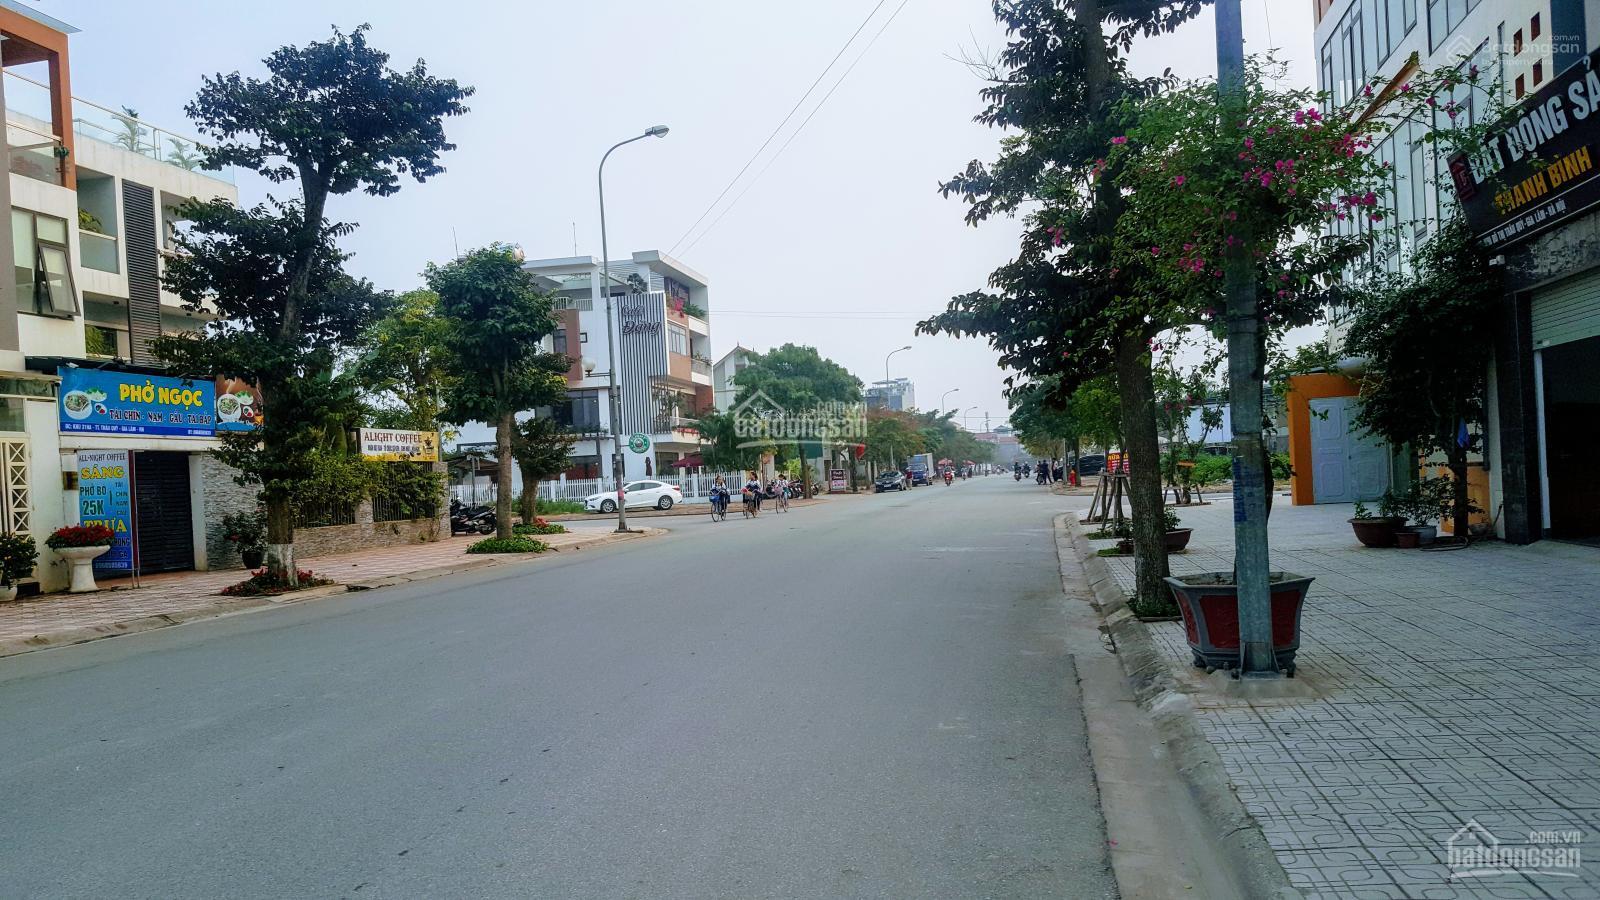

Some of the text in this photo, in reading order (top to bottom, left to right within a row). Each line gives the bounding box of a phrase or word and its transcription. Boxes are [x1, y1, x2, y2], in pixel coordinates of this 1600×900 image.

[119, 379, 203, 411] PHỞ NGỌC
[364, 431, 423, 444] ALIGHT COFFEE
[81, 463, 125, 480] SÁNG
[82, 500, 105, 516] 25K
